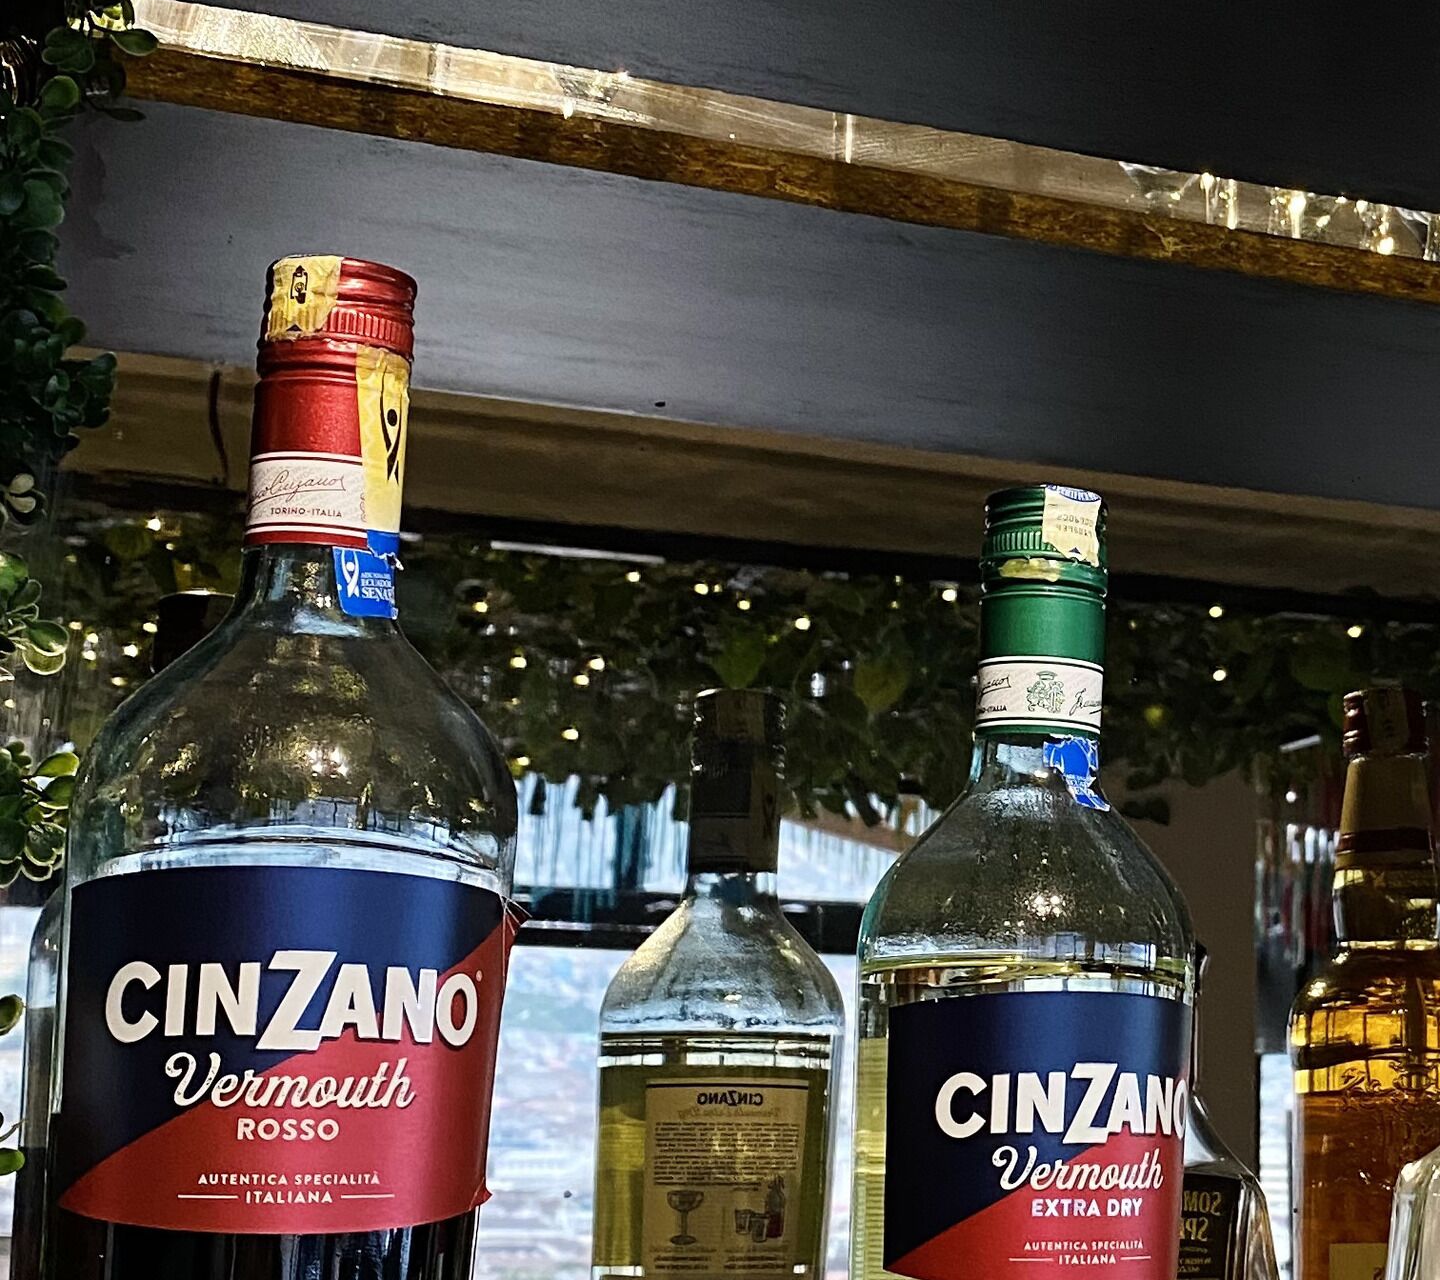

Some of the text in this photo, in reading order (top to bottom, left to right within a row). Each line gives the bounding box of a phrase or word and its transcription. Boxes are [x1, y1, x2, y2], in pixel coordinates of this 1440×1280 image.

[105, 950, 478, 1052] CINZANO
[165, 1052, 416, 1108] Vermouth
[237, 1118, 339, 1141] ROSSO
[992, 1145, 1163, 1191] Vermouth
[198, 1171, 380, 1185] AUTENTICA SPECIALITÀ
[246, 1191, 333, 1204] ITALIANA
[1032, 1198, 1142, 1217] EXTRA DRY
[1024, 1239, 1143, 1251] AUTENTICA SPECIALITÀ
[1058, 1254, 1116, 1264] ITALIANA
